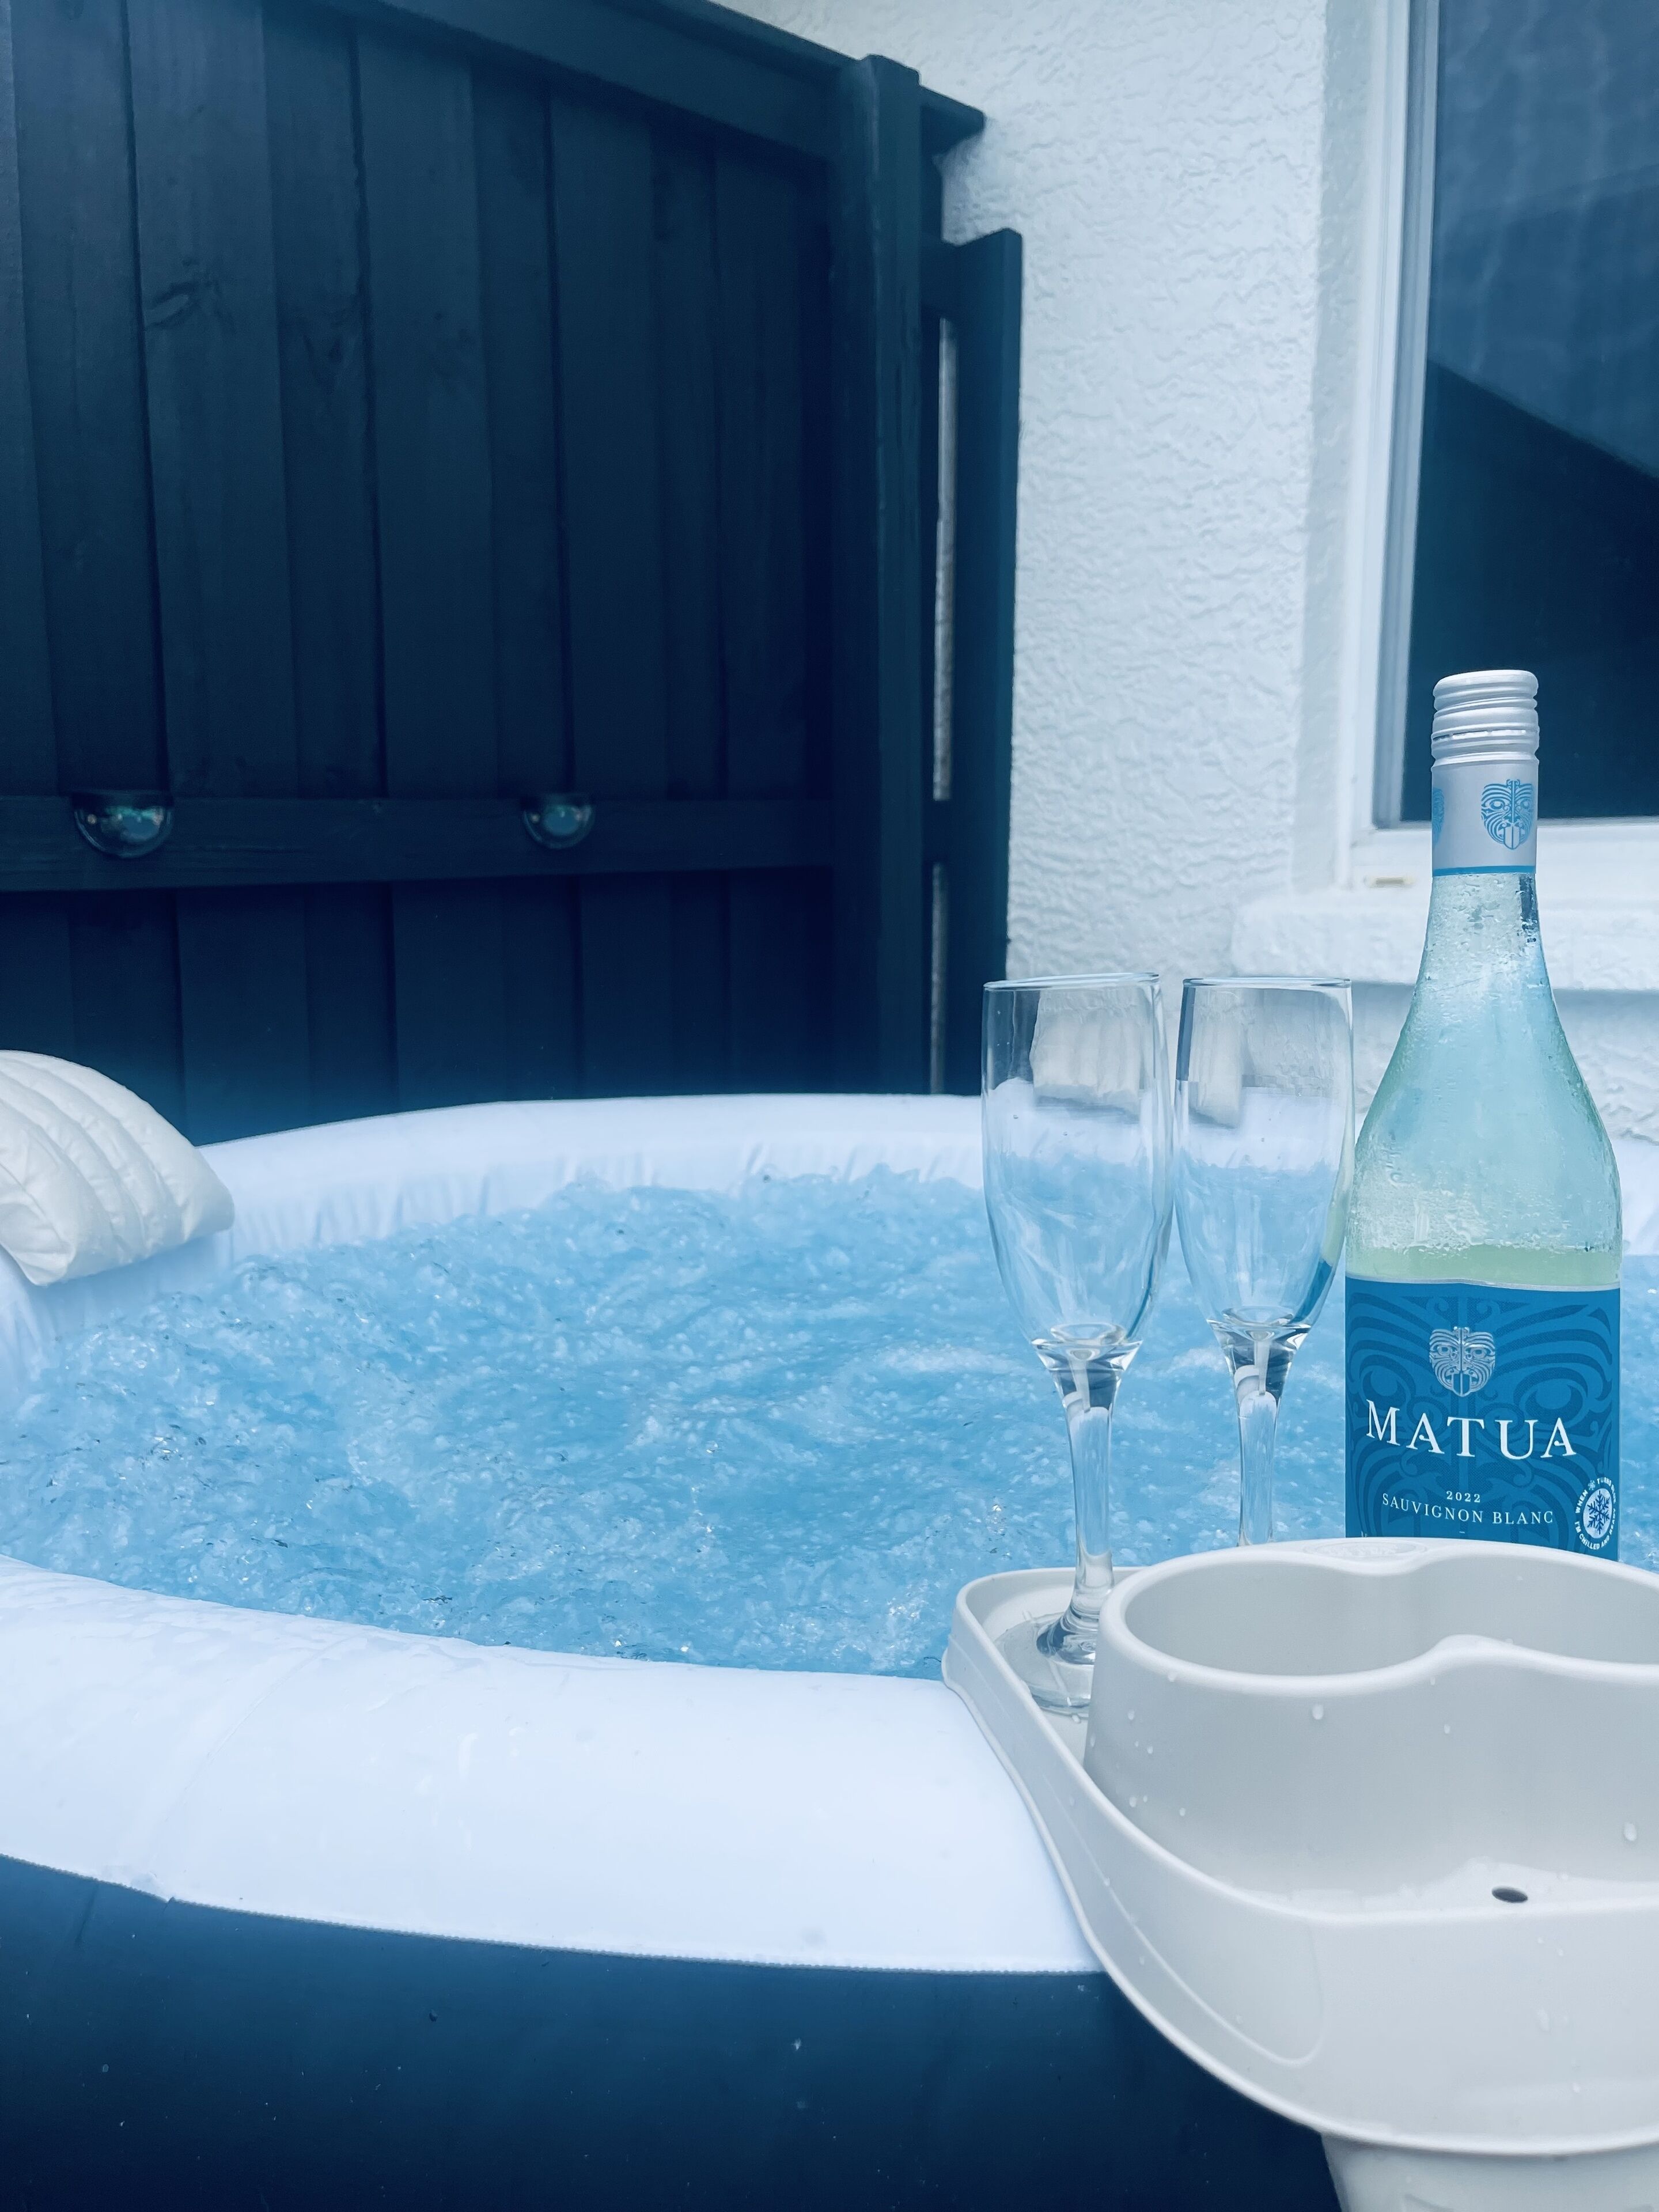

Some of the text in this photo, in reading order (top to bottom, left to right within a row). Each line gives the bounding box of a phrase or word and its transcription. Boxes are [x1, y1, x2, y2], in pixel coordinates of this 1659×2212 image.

[1366, 1399, 1576, 1460] MATUA
[1382, 1493, 1554, 1524] SAUVIGNON BLANC
[1446, 1490, 1481, 1503] 2022
[1575, 1490, 1588, 1514] WHEN
[1579, 1533, 1600, 1550] CHILLED
[1601, 1535, 1610, 1548] AND
